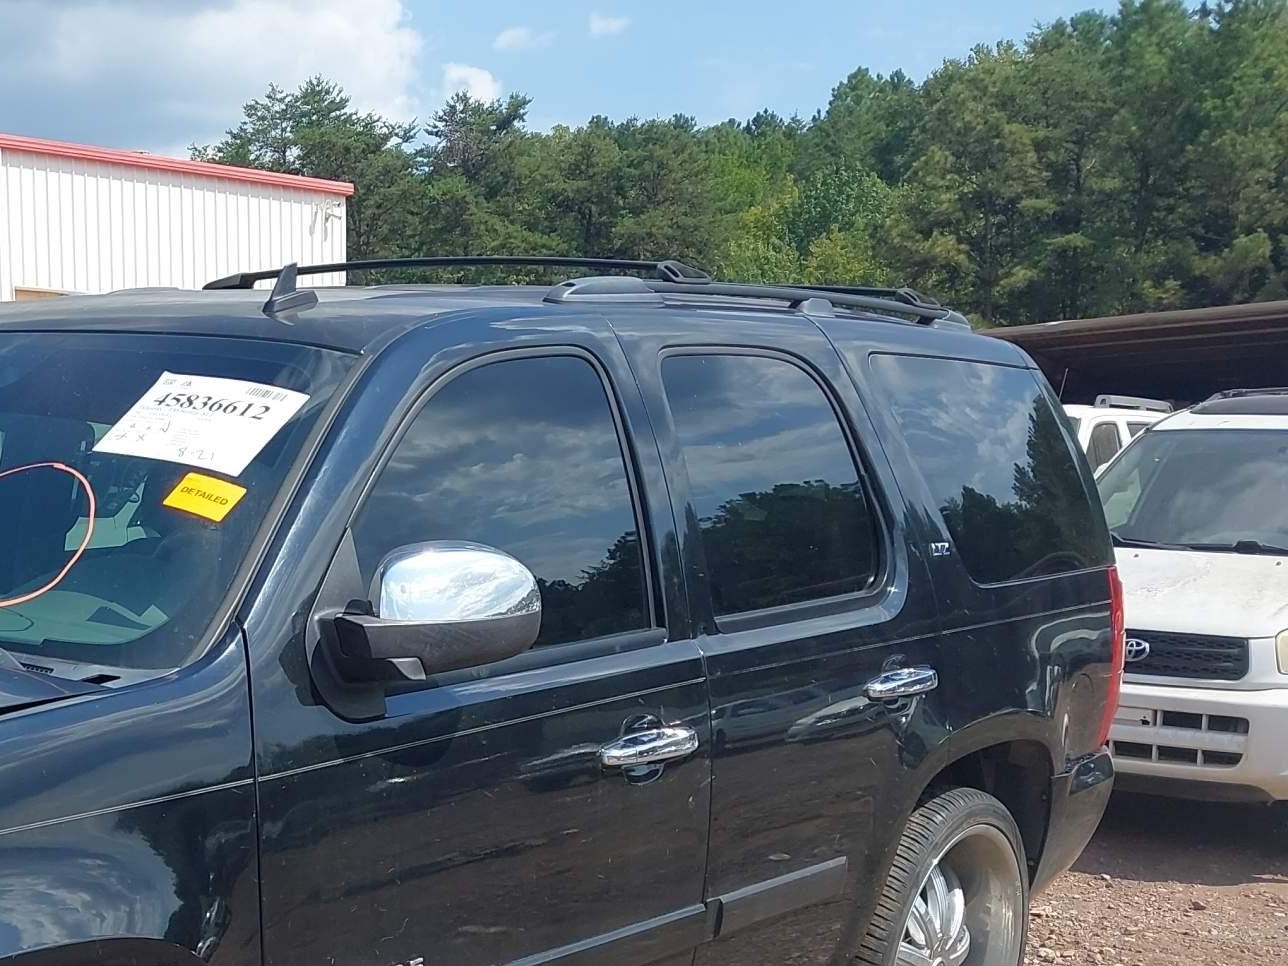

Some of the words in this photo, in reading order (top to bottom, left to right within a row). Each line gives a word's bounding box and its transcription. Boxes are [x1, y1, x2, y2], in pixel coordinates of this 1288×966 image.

[153, 392, 272, 420] 45836612
[180, 486, 229, 506] DETAILED
[931, 542, 951, 556] LTZ
